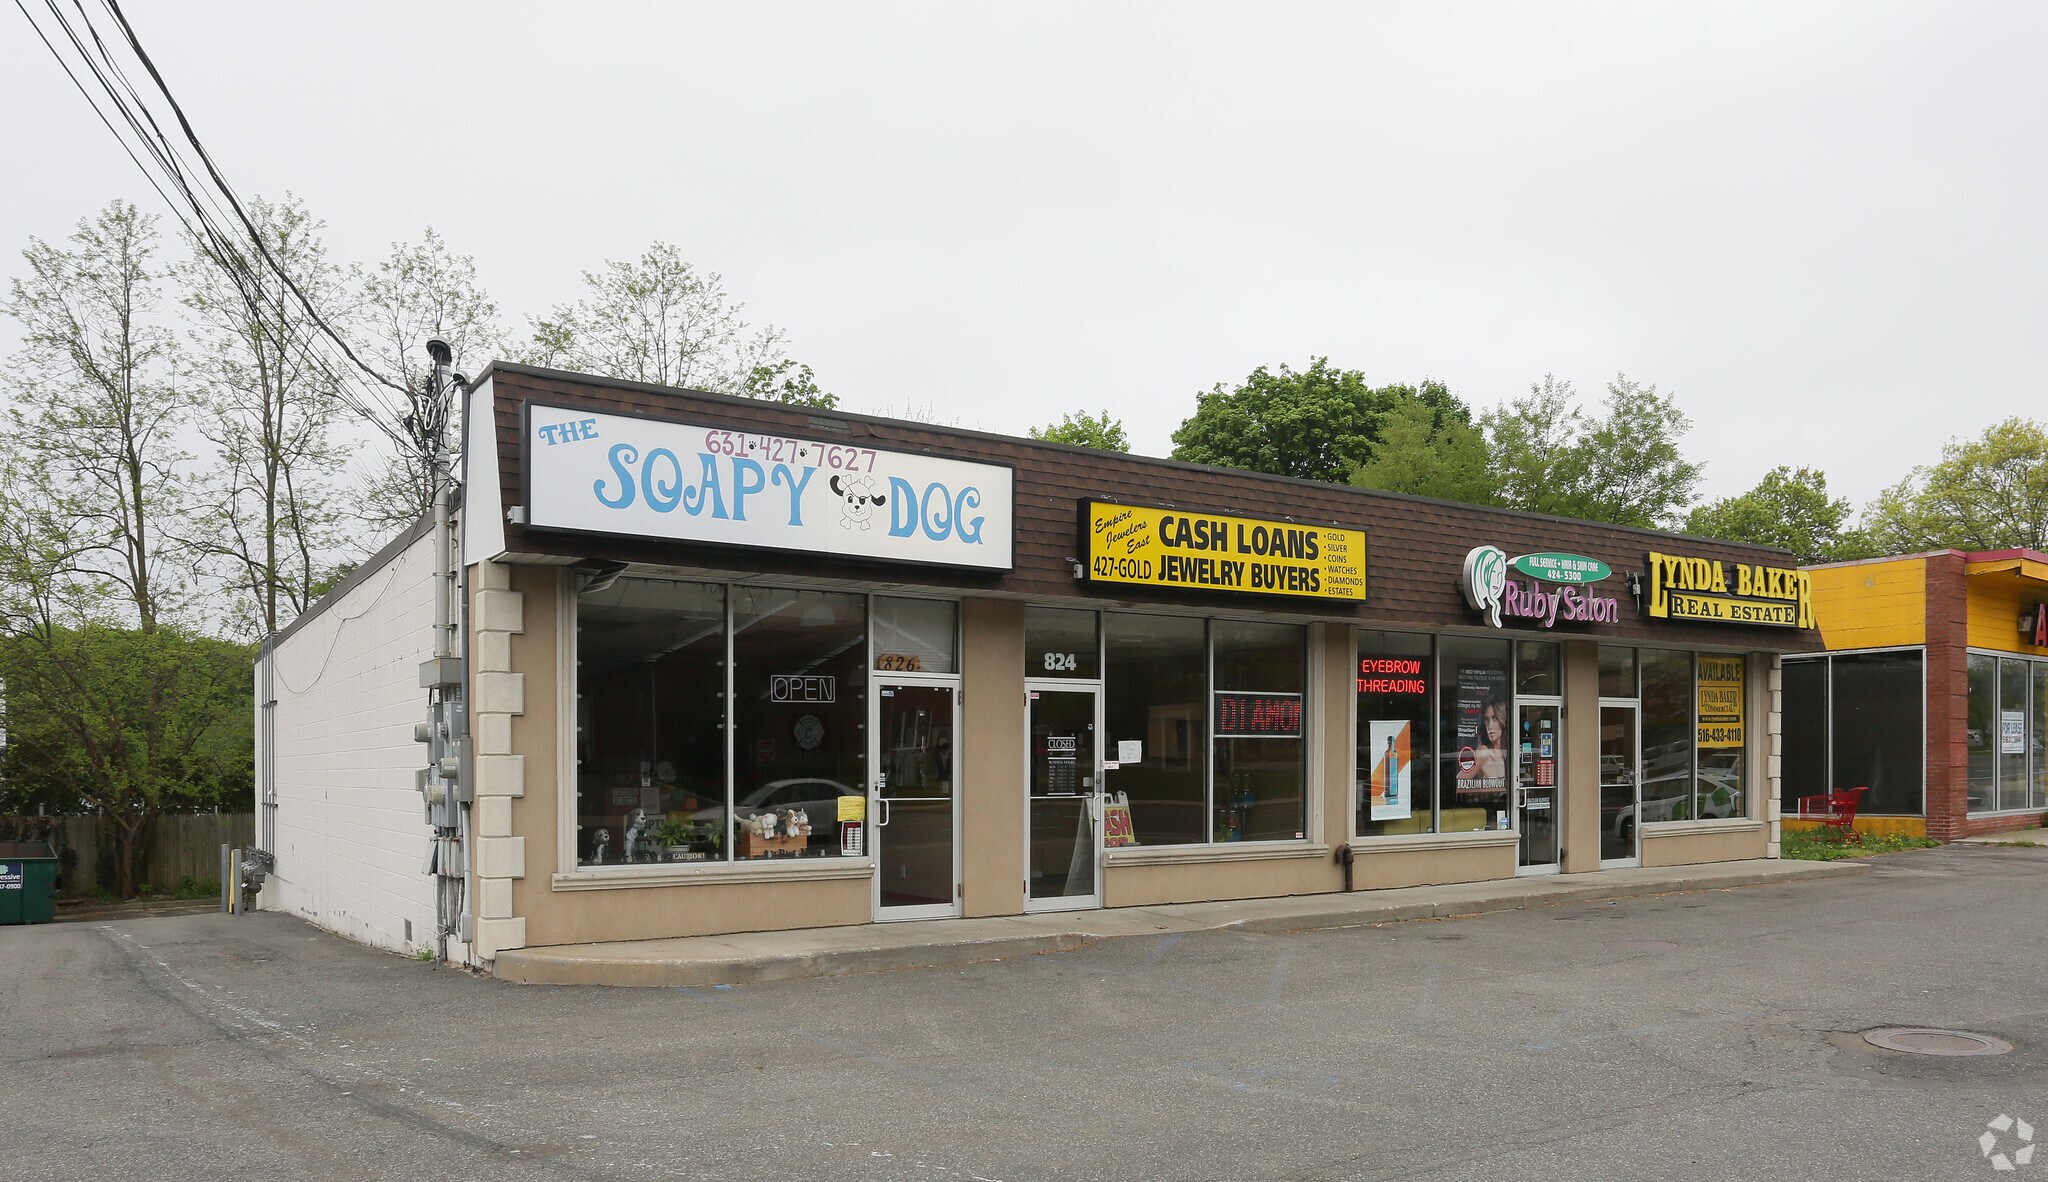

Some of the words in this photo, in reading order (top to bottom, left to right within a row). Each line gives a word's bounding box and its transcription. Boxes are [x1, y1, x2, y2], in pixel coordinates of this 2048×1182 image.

[538, 418, 600, 447] THE
[593, 442, 817, 528] SOAPY
[886, 475, 985, 545] DOG
[1094, 510, 1133, 534] Empire
[1106, 521, 1149, 550] Jewelers
[1126, 535, 1151, 554] East
[1158, 515, 1228, 553] CASH
[1237, 524, 1319, 560] LOANS
[1327, 532, 1345, 541] GOLD
[1327, 543, 1347, 553] SILVER
[1327, 554, 1347, 563] COINS
[1529, 556, 1540, 567] FULL
[1540, 557, 1557, 569] SERVICE
[1561, 559, 1572, 570] HAIR
[1577, 561, 1587, 571] SKIN
[1587, 562, 1599, 572] CARE
[1093, 557, 1152, 580] 427-GOLD
[1158, 555, 1246, 586] JEWELRY
[1251, 563, 1320, 592] BUYERS
[1327, 565, 1358, 575] WATCHES
[1328, 576, 1363, 586] DIAMONDS
[1649, 551, 1727, 619] LYNDA
[1737, 563, 1815, 630] BAKER
[1328, 587, 1353, 596] ESTATES
[1504, 580, 1559, 628] Ruby
[1562, 585, 1619, 624] Salon
[1672, 596, 1724, 617] REAL
[1731, 605, 1795, 623] ESTATE
[884, 656, 916, 671] 826
[1044, 652, 1077, 671] 824
[1362, 659, 1421, 675] EYEBROW
[1697, 662, 1740, 681] AVAILABLE
[773, 677, 834, 701] OPEN
[1357, 679, 1425, 694] THREADING
[1701, 691, 1718, 707] LYNDA
[1719, 690, 1737, 707] BAKER
[1048, 739, 1075, 749] CLOSED
[1697, 728, 1742, 742] 516-433-4110
[1457, 779, 1481, 789] BRAZILIAN
[1482, 778, 1505, 788] BLOWOUT
[1104, 808, 1132, 836] ASH
